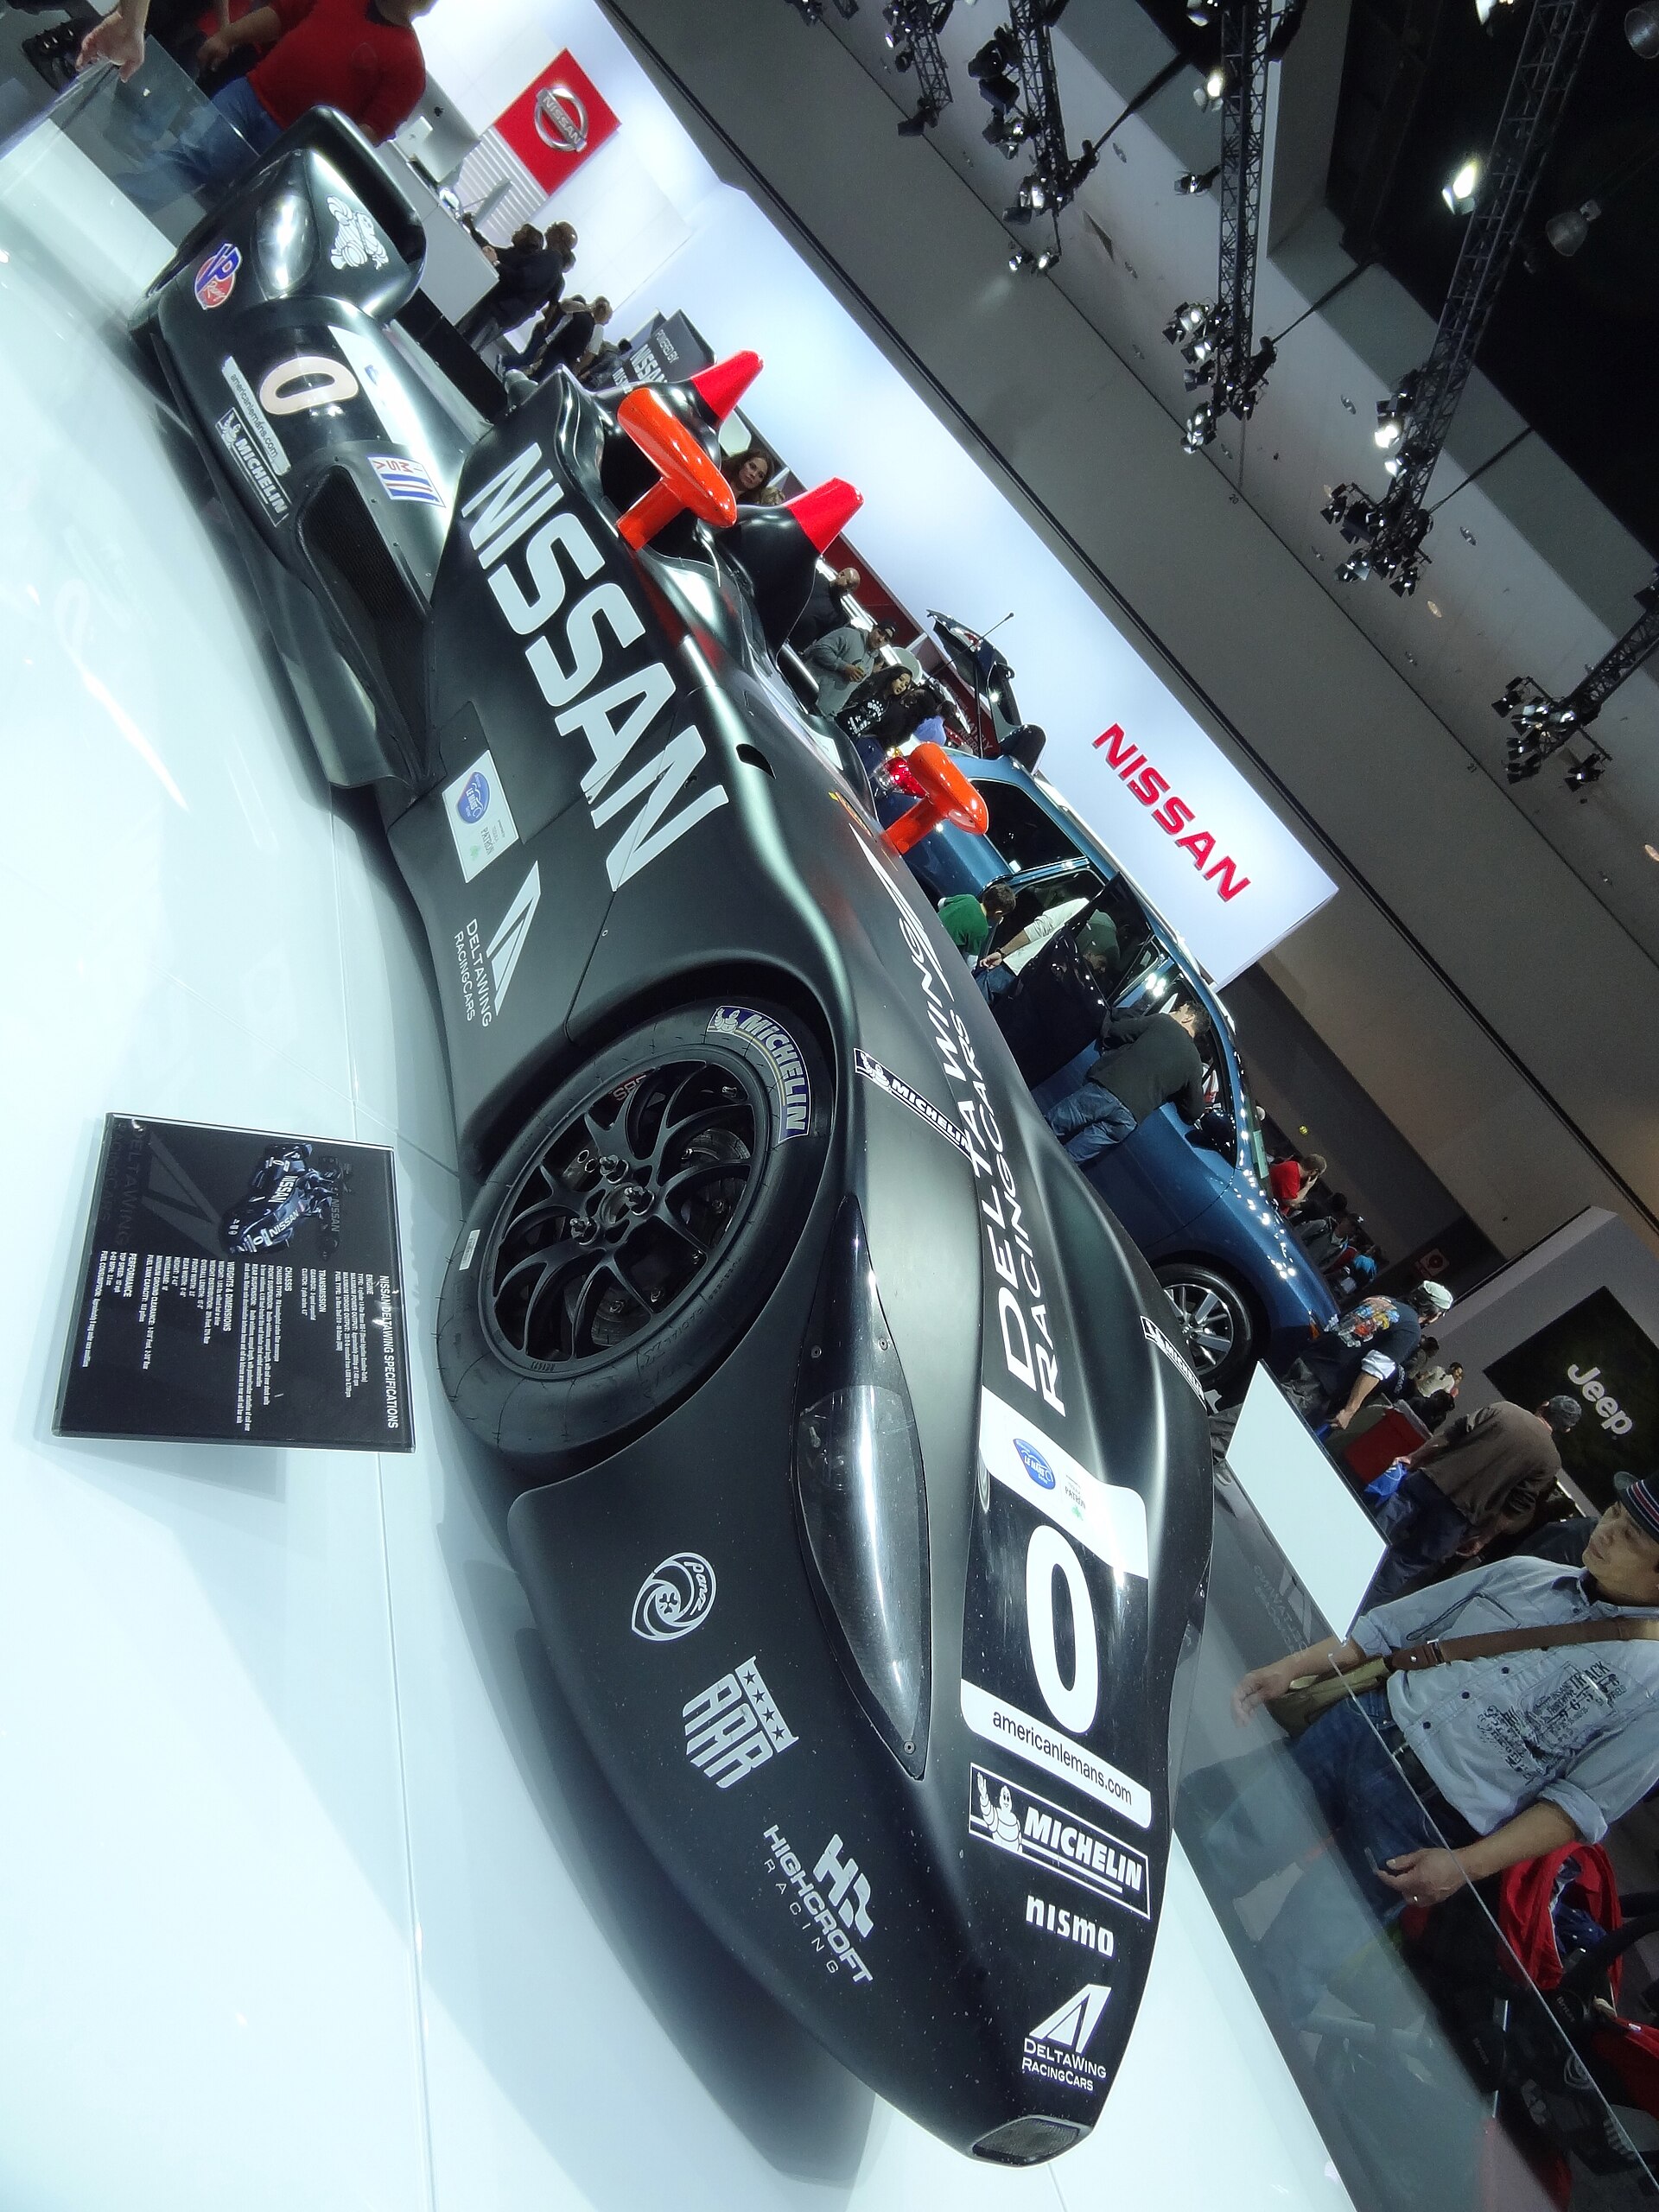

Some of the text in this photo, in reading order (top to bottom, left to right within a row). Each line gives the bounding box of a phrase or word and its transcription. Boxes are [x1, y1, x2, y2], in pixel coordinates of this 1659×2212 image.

[542, 95, 582, 145] NISSAN
[667, 351, 679, 364] BY
[259, 356, 359, 415] 0
[230, 372, 279, 460] americanlemans.com
[235, 439, 289, 515] MICHELIN
[461, 442, 729, 893] NISSAN
[1093, 722, 1251, 903] NISSAN
[454, 933, 477, 1021] RACINGCARS
[466, 918, 493, 1028] DELTAWING
[740, 1013, 806, 1130] MICHELIN
[890, 1077, 972, 1154] MICHELIN
[268, 1176, 298, 1203] NISSAN
[331, 1198, 340, 1232] NISSAN
[94, 1262, 106, 1297] CONSUMPTION:
[99, 1251, 108, 1262] FUEL
[107, 1262, 116, 1273] MPH:
[117, 1262, 125, 1278] SPEED:
[123, 1253, 137, 1297] PERFORMANCE
[154, 1255, 162, 1275] MINIMUM
[163, 1256, 172, 1284] WHEELBASE:
[226, 1262, 235, 1287] WEIGHTS
[142, 1279, 150, 1301] CAPACITY:
[148, 1296, 158, 1325] CLEARANCE:
[152, 1276, 161, 1295] GROUND
[207, 1277, 215, 1309] DISTRIBUTION:
[318, 1270, 327, 1313] TRANSMISSION
[223, 1294, 233, 1332] DIMENSIONS
[379, 1275, 398, 1428] NISSAN DELTAWING SPECIFICATIONS
[1164, 1339, 1205, 1401] MICHELIN
[1567, 1363, 1634, 1437] Jeep
[1025, 1524, 1099, 1733] 0
[682, 1672, 773, 1789] AAR
[992, 1709, 1133, 1806] americanlemans.com
[1024, 1806, 1142, 1891] MICHELIN
[763, 1824, 874, 1983] HIGHCROFT
[763, 1859, 839, 1974] RACING
[1026, 1894, 1115, 1957] nismo
[1021, 2056, 1094, 2092] RACINGCARS
[1023, 2037, 1107, 2079] DELTAWING
